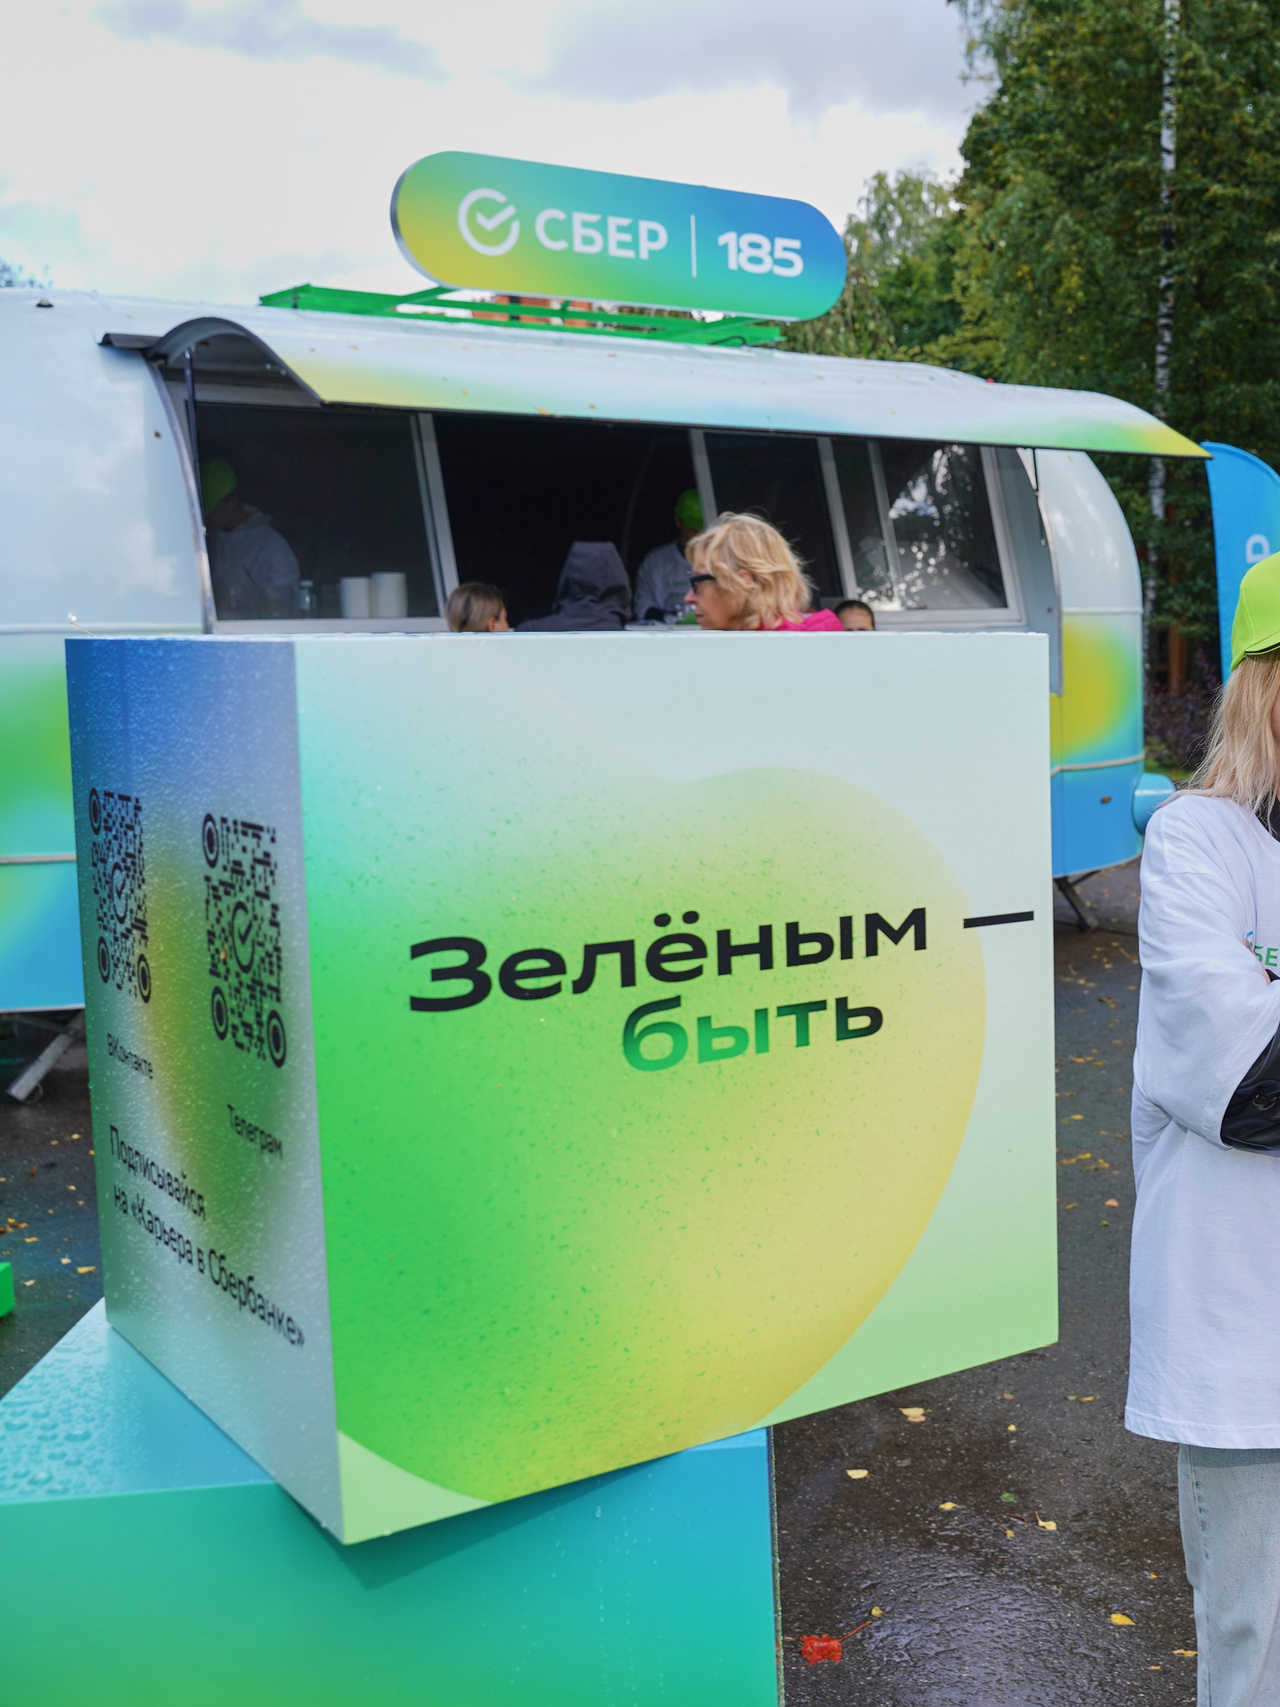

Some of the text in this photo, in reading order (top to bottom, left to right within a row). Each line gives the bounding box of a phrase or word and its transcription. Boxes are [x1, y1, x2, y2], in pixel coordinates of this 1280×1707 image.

[534, 207, 805, 278] СБЕР 185
[409, 907, 927, 1013] Зелёным
[107, 1032, 154, 1080] ВКонтакте
[622, 996, 884, 1073] быть
[227, 1103, 284, 1160] Телеграм
[110, 1124, 206, 1222] Подписывайся
[113, 1185, 306, 1348] на «Карьера в Сбербанке»
